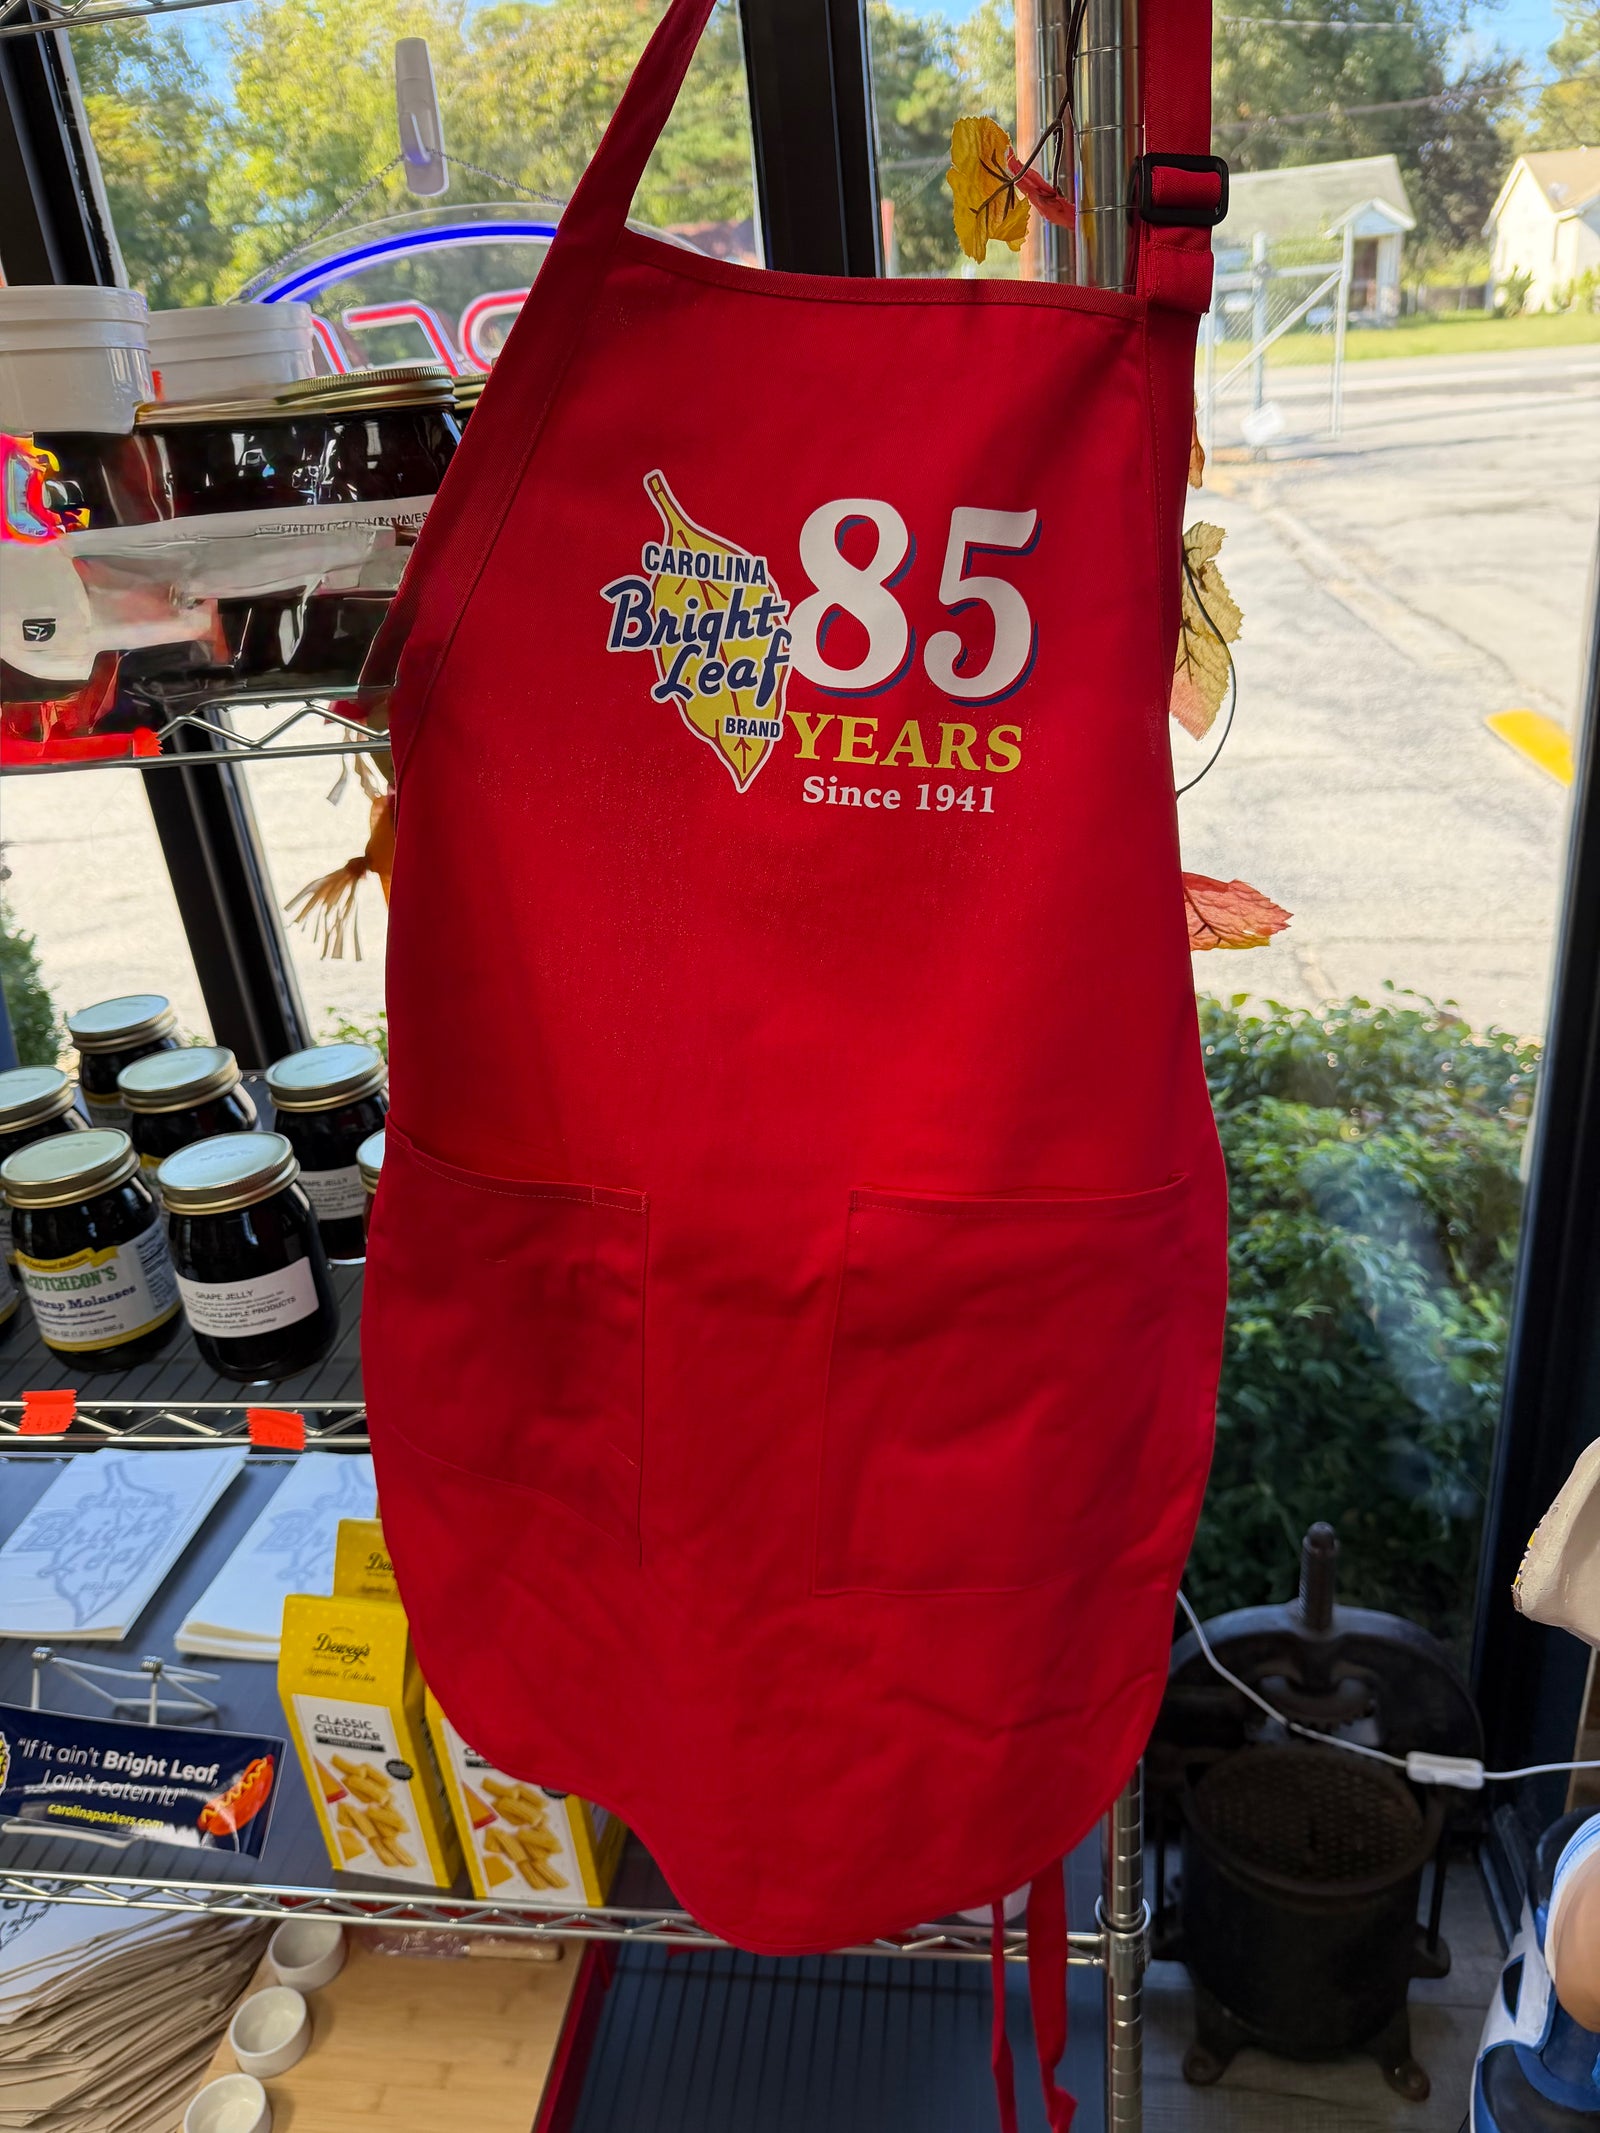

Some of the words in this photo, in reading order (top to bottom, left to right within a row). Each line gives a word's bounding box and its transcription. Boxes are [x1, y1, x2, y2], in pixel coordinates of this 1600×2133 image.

[643, 545, 767, 585] CAROLINA
[604, 580, 786, 658] Bright
[788, 498, 1042, 707] 85
[654, 630, 791, 707] Leaf
[725, 716, 781, 739] BRAND
[786, 711, 1023, 773] YEARS
[802, 776, 901, 811] Since
[916, 784, 996, 814] 1941
[314, 1723, 381, 1741] CHEDDAR
[316, 1713, 373, 1731] CLASSIC
[39, 1741, 54, 1760] it
[56, 1744, 100, 1766] ain't
[102, 1750, 167, 1776] Bright
[170, 1759, 220, 1787] Leaf,
[47, 1802, 164, 1830] carolinapackers.com
